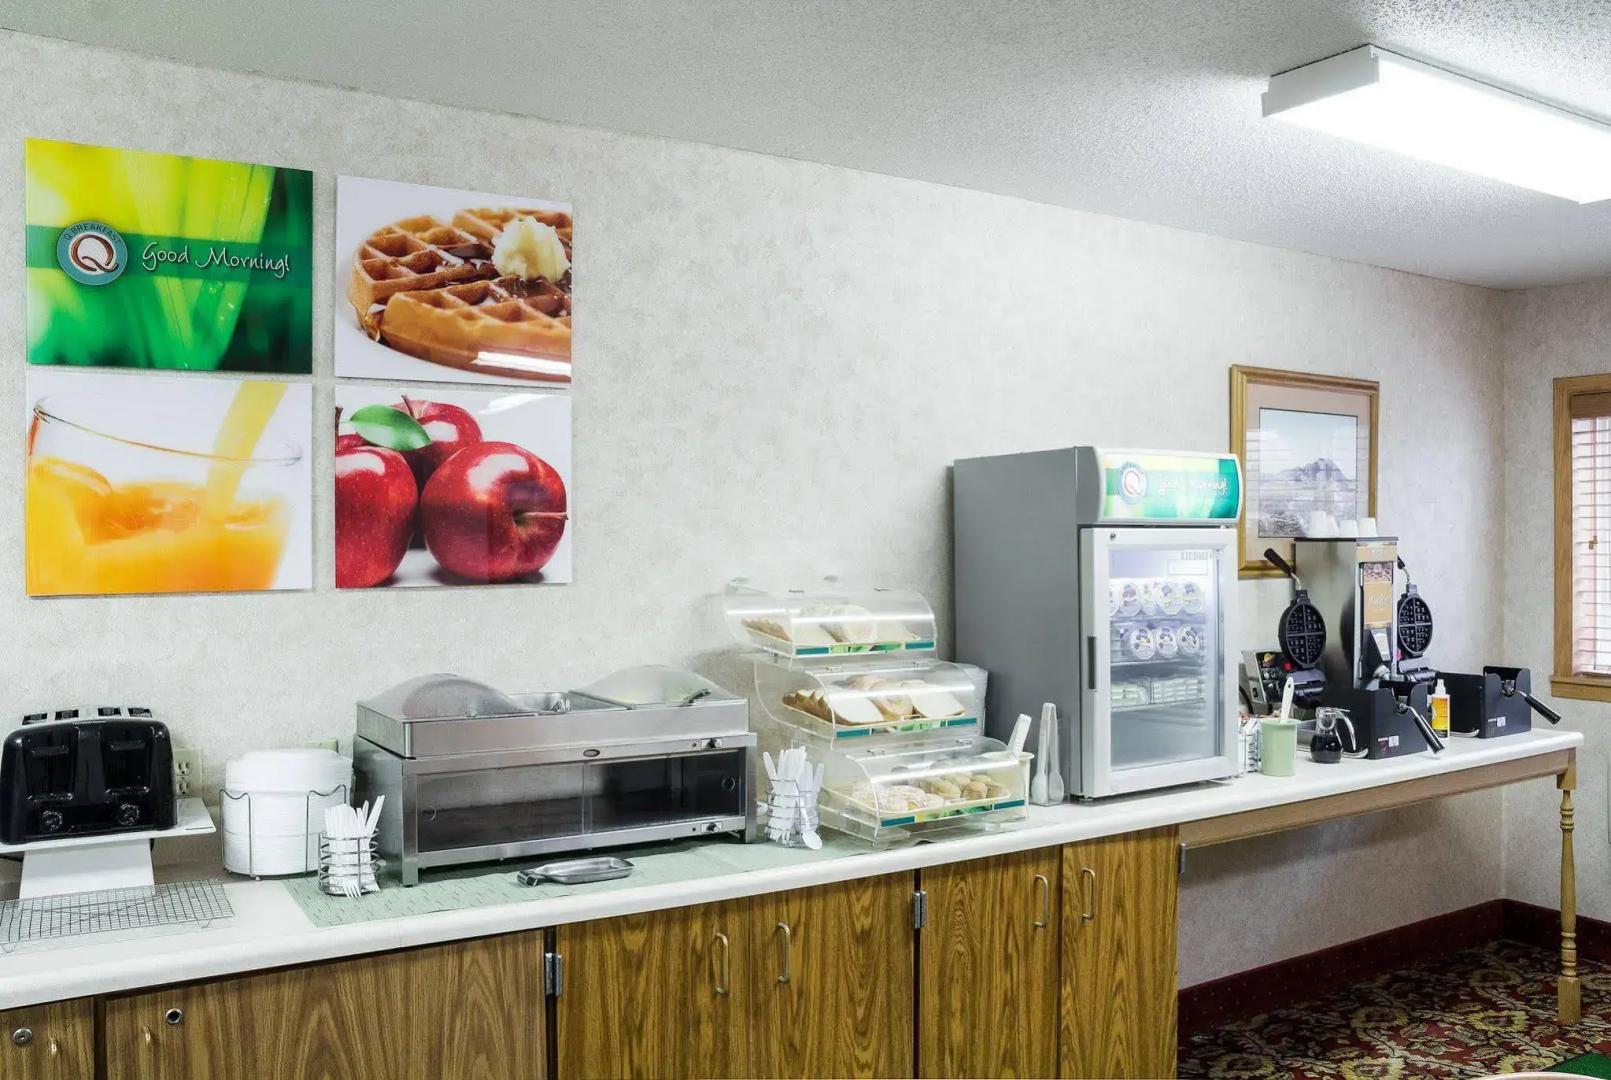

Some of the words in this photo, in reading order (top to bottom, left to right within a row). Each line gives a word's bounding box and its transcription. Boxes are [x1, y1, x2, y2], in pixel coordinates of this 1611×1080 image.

[70, 223, 122, 244] BREAKFAST
[70, 233, 119, 273] Q
[142, 241, 190, 271] Good
[195, 246, 290, 278] Morning!
